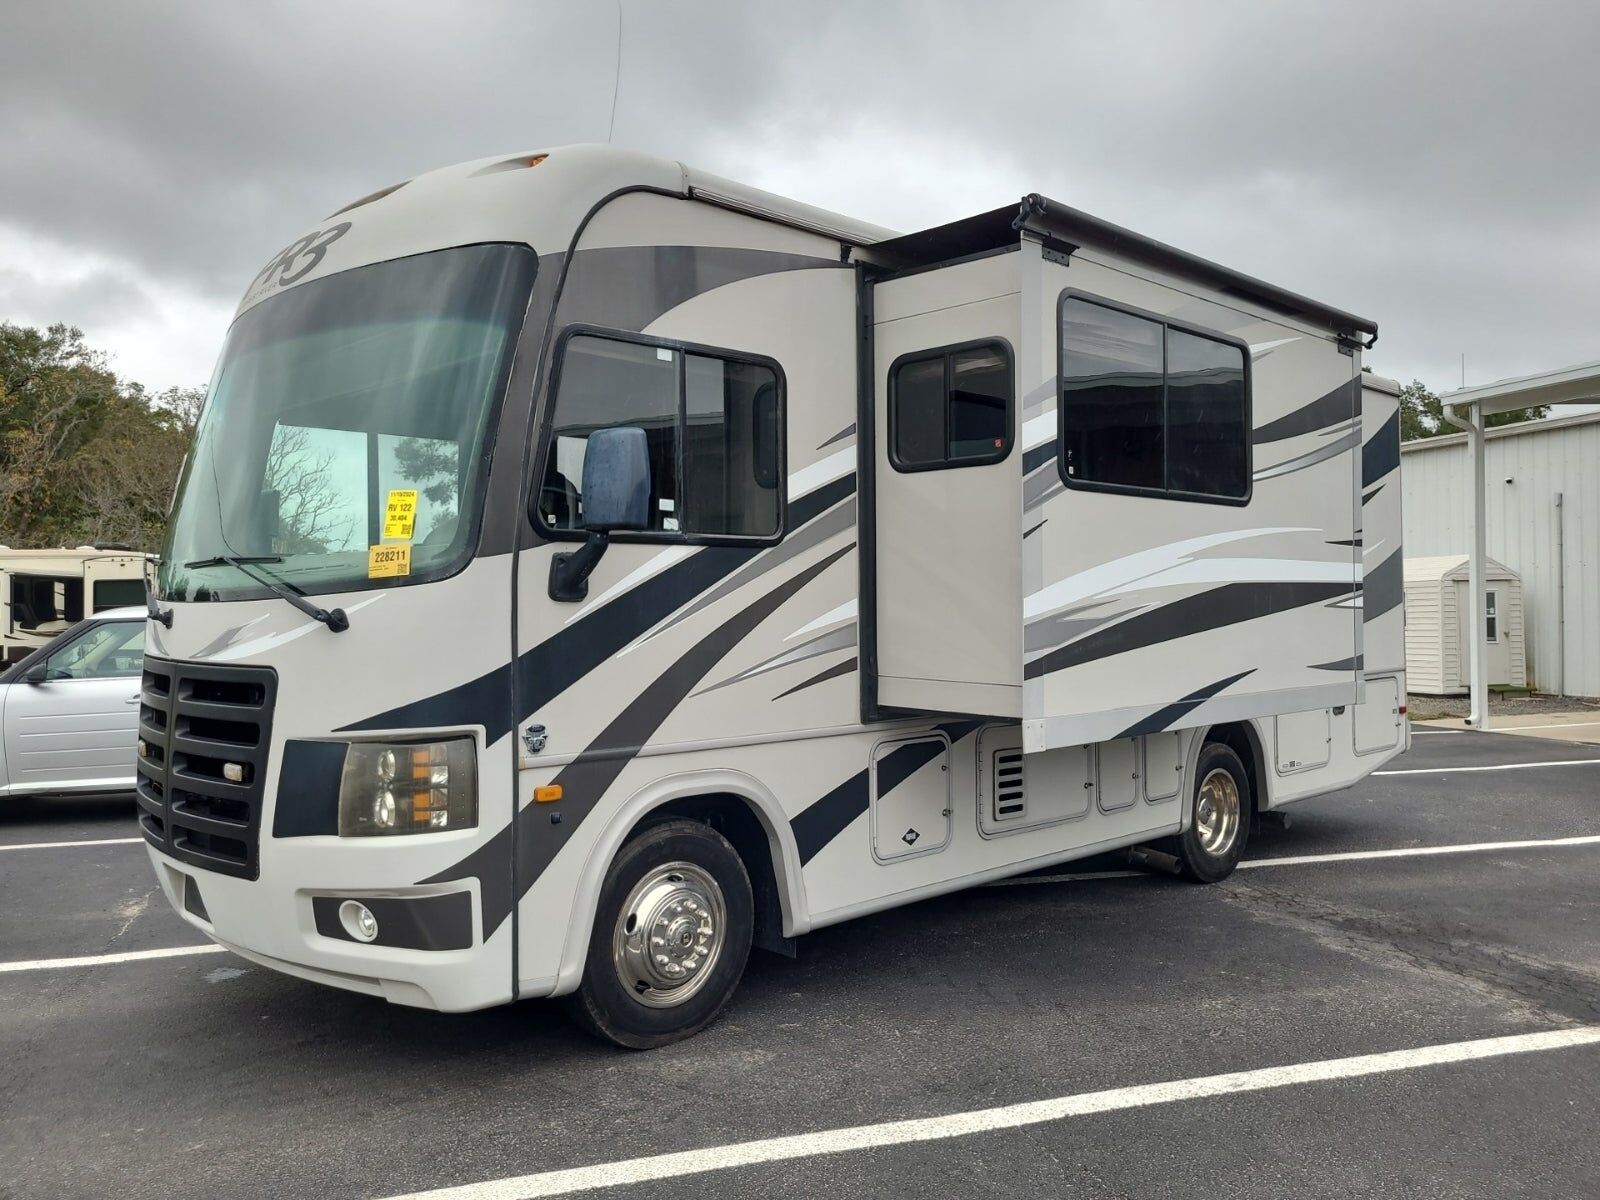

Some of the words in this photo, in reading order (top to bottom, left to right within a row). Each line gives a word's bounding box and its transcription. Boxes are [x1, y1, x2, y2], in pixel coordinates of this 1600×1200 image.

[388, 503, 398, 511] RV
[400, 503, 412, 511] 122
[374, 550, 405, 563] 228211
